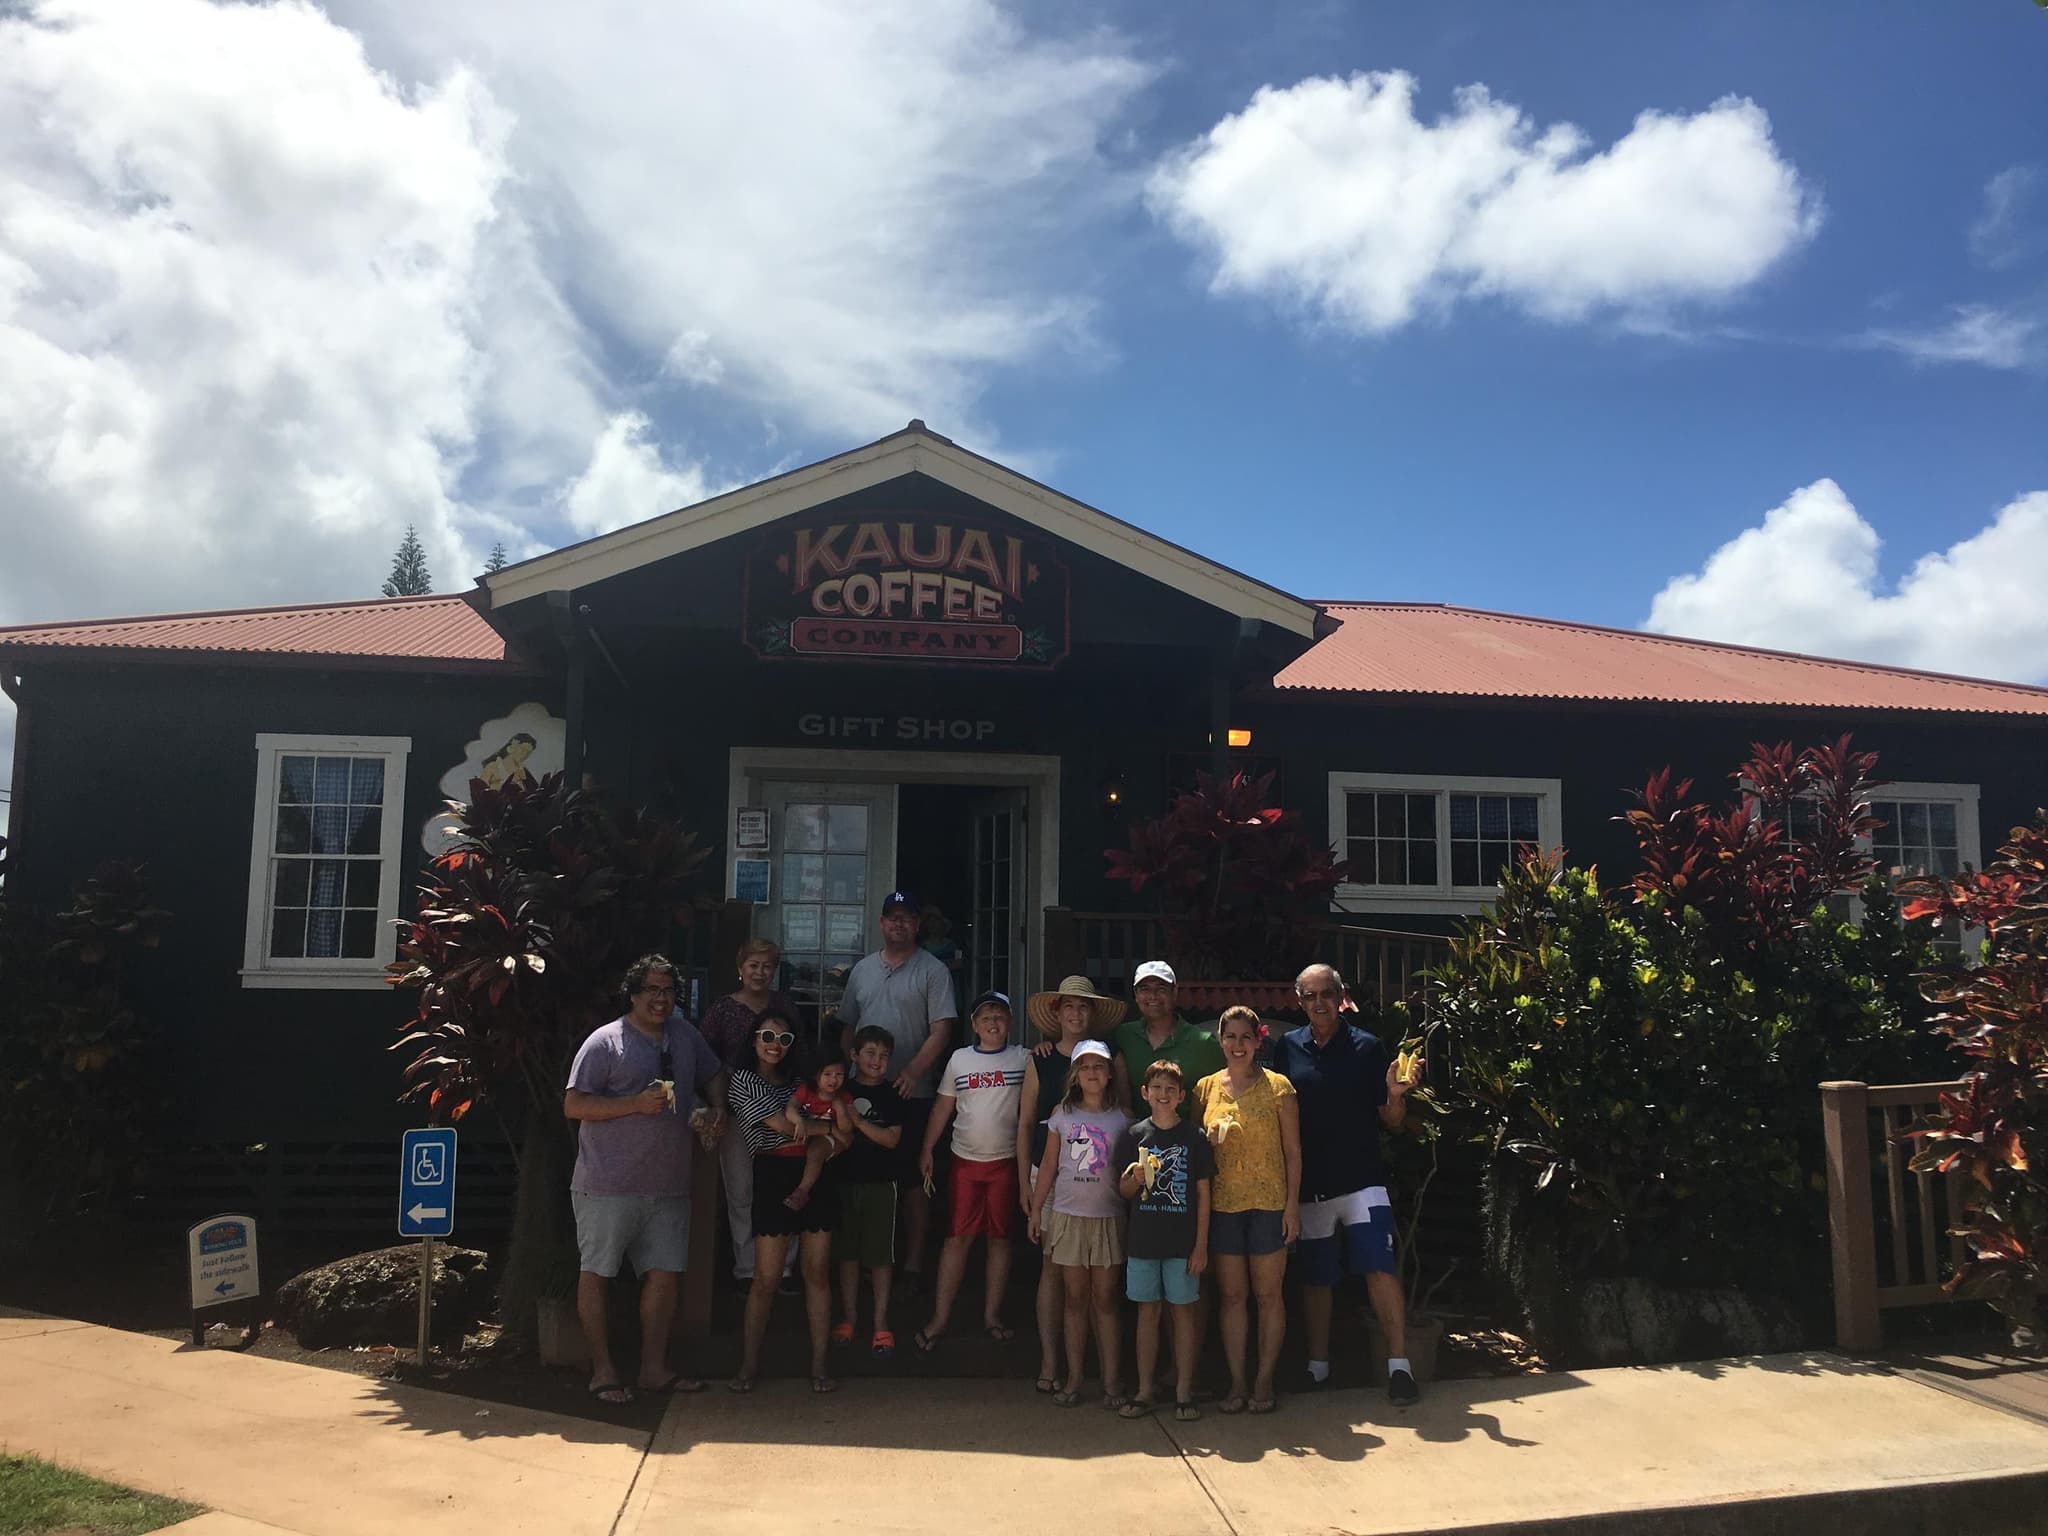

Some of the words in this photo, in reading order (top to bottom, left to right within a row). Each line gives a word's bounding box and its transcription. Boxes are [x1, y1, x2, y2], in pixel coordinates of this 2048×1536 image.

[793, 522, 1024, 603] KAUAI
[812, 569, 1003, 622] COFFEE
[807, 627, 1009, 650] COMPANY
[799, 713, 885, 738] GIFT
[896, 716, 996, 741] SHOP
[968, 1070, 1006, 1089] USA
